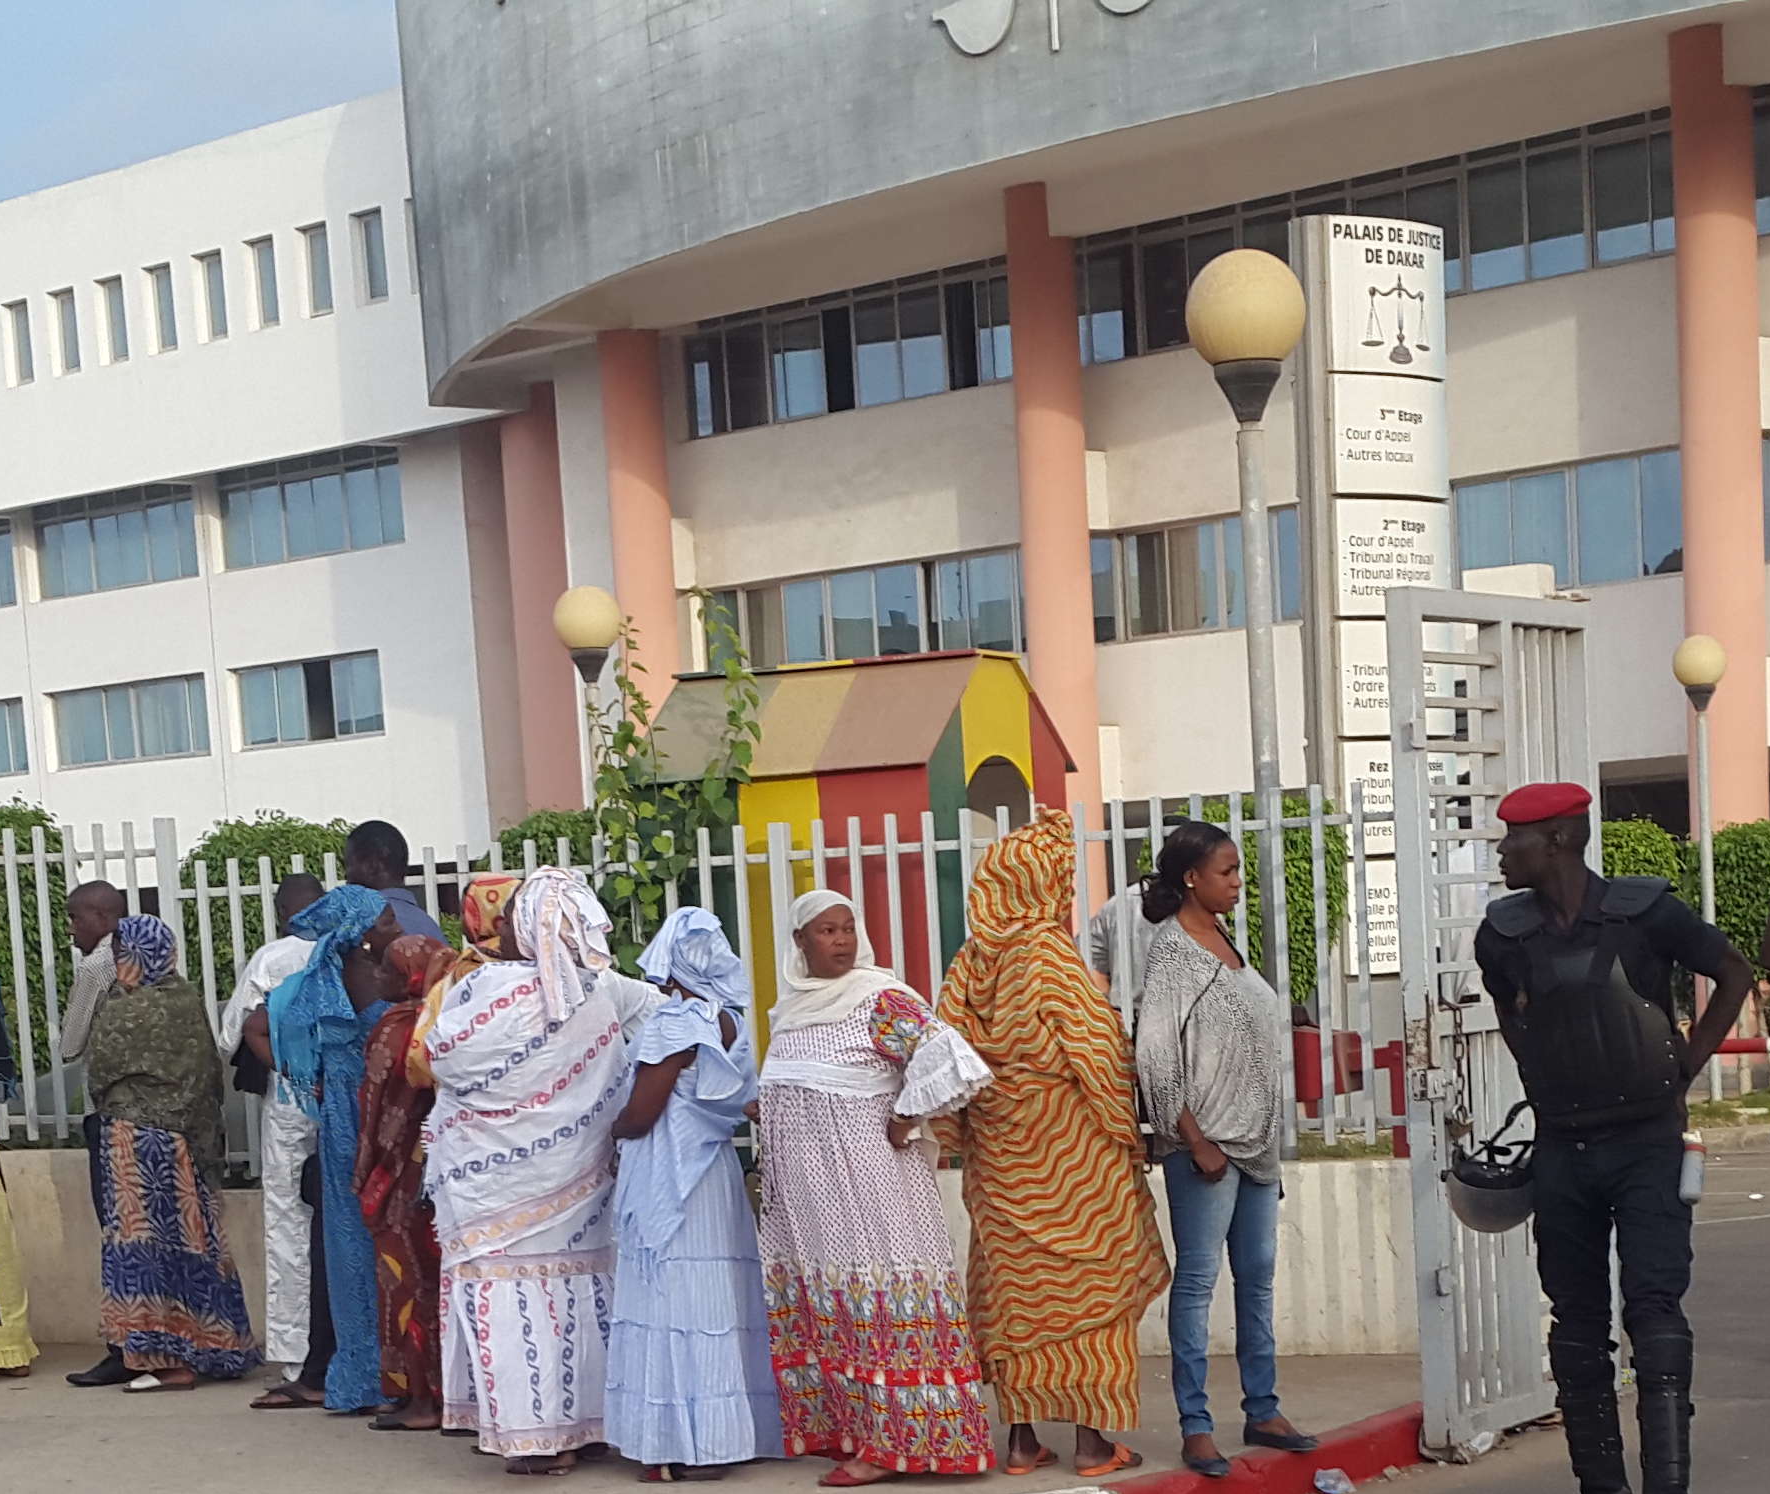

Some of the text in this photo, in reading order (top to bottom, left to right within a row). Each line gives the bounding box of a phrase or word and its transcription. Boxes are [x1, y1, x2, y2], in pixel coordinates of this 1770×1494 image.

[1333, 223, 1441, 251] PALAIS DE JUSTICE
[1365, 247, 1425, 270] DE DAKAR
[1398, 410, 1423, 425] Etage
[1346, 428, 1412, 443] Cour d'Appel
[1347, 448, 1414, 463] Autres locaux
[1401, 520, 1426, 534] Etage
[1349, 535, 1414, 548] Cour d'Appel
[1349, 551, 1394, 564] Tribunal
[1396, 552, 1408, 564] du
[1349, 567, 1394, 580] Tribunal
[1350, 584, 1387, 597] Autres
[1352, 680, 1385, 693] Ordre
[1353, 696, 1389, 709] Autres
[1369, 761, 1389, 773] Rez
[1365, 824, 1393, 837] utres
[1367, 887, 1391, 899] EMO
[1366, 903, 1385, 916] alle
[1368, 934, 1397, 947] ellule
[1369, 951, 1397, 963] utres
